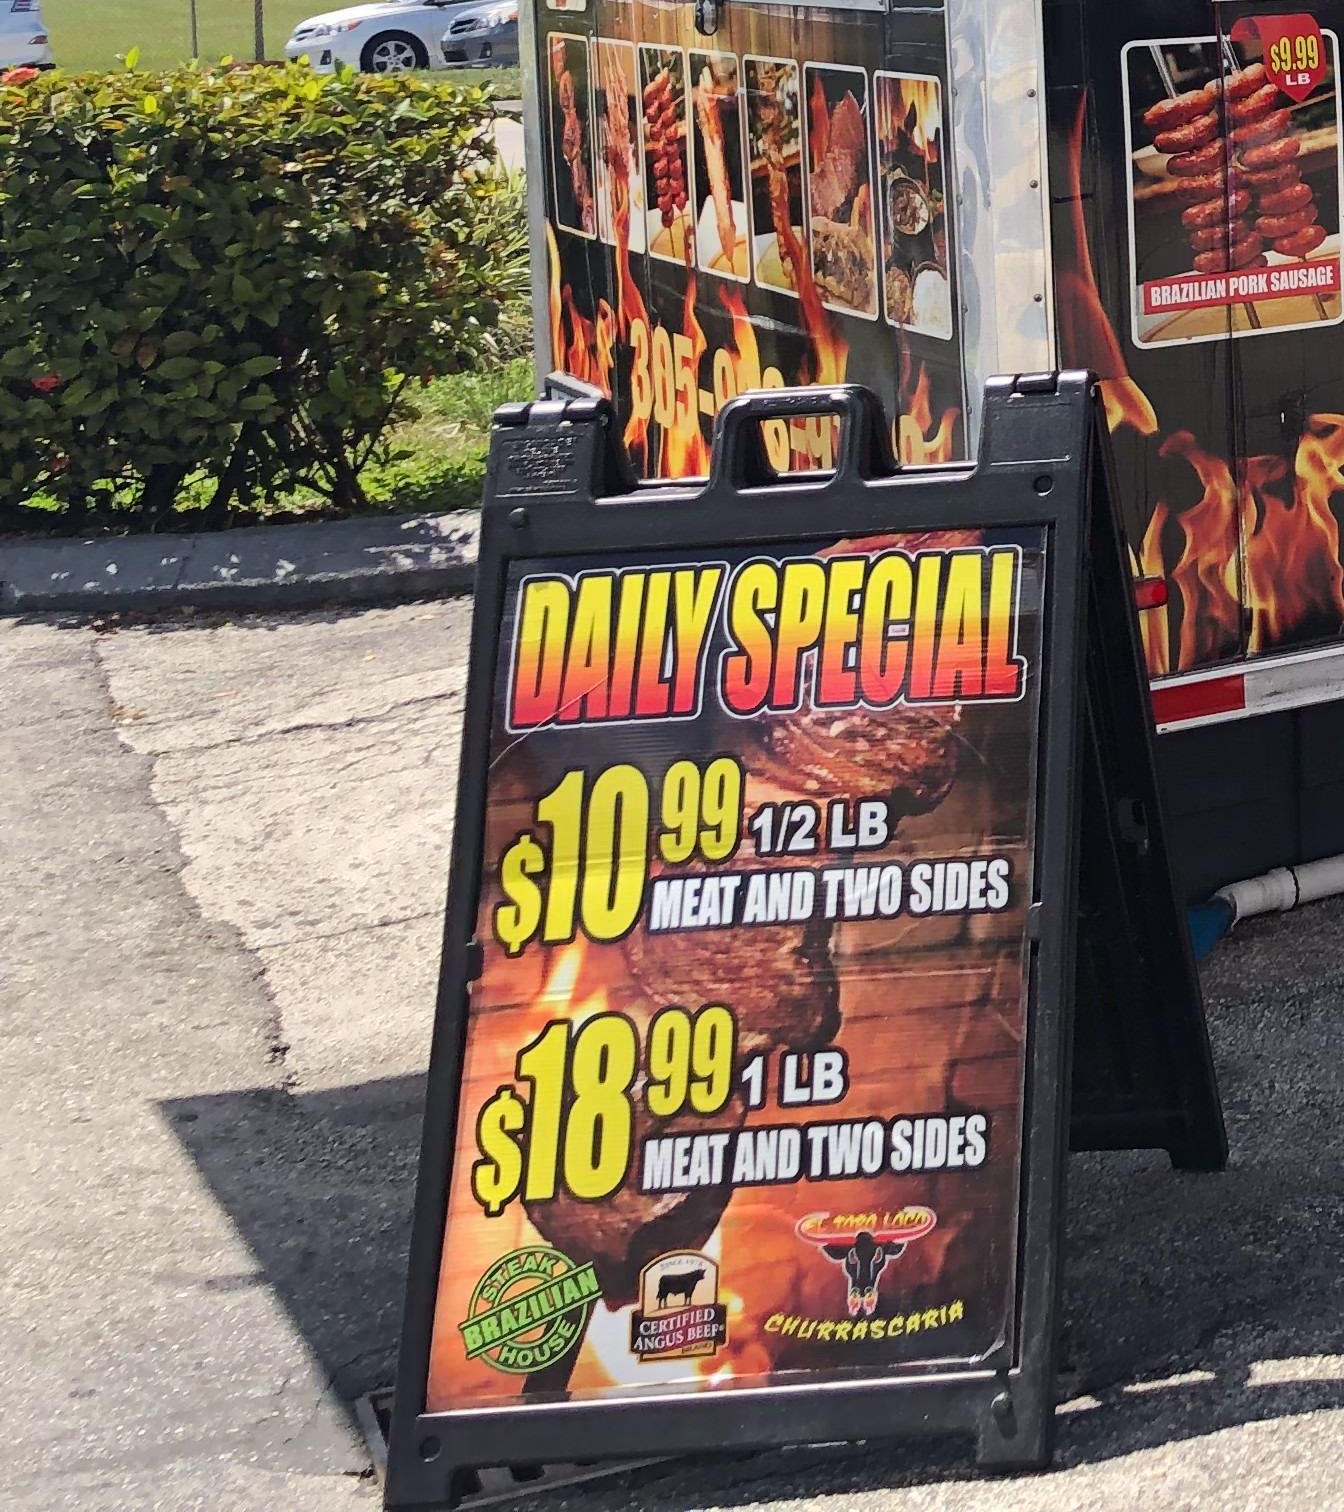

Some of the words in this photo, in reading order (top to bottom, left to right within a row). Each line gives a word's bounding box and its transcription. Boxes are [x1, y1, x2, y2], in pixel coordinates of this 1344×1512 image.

[1271, 35, 1319, 73] $9.99
[1285, 72, 1311, 86] LB
[1151, 276, 1226, 306] BRAZILIAN
[1229, 272, 1268, 297] PORK
[1270, 267, 1334, 290] SAUSAGE
[507, 565, 726, 731] DAILY
[721, 548, 1023, 715] SPECIAL
[752, 805, 817, 852] 1/2
[831, 801, 889, 849] LB
[650, 879, 742, 931] MEAT
[743, 875, 817, 923] AND
[822, 866, 902, 917] TWO
[909, 859, 1010, 911] SIDES
[742, 1056, 765, 1106] 1
[781, 1052, 845, 1102] LB
[642, 1136, 726, 1190] MEAT
[734, 1129, 801, 1183] AND
[808, 1123, 878, 1176] TWO
[890, 1116, 986, 1170] SIDES
[482, 1255, 556, 1302] STEAK
[463, 1269, 598, 1351] BRAZILIAN
[640, 1308, 715, 1335] CERTIFIED
[764, 1299, 964, 1343] CHURRASCARIA
[500, 1320, 575, 1365] HOUSE
[634, 1330, 684, 1350] ANGUS
